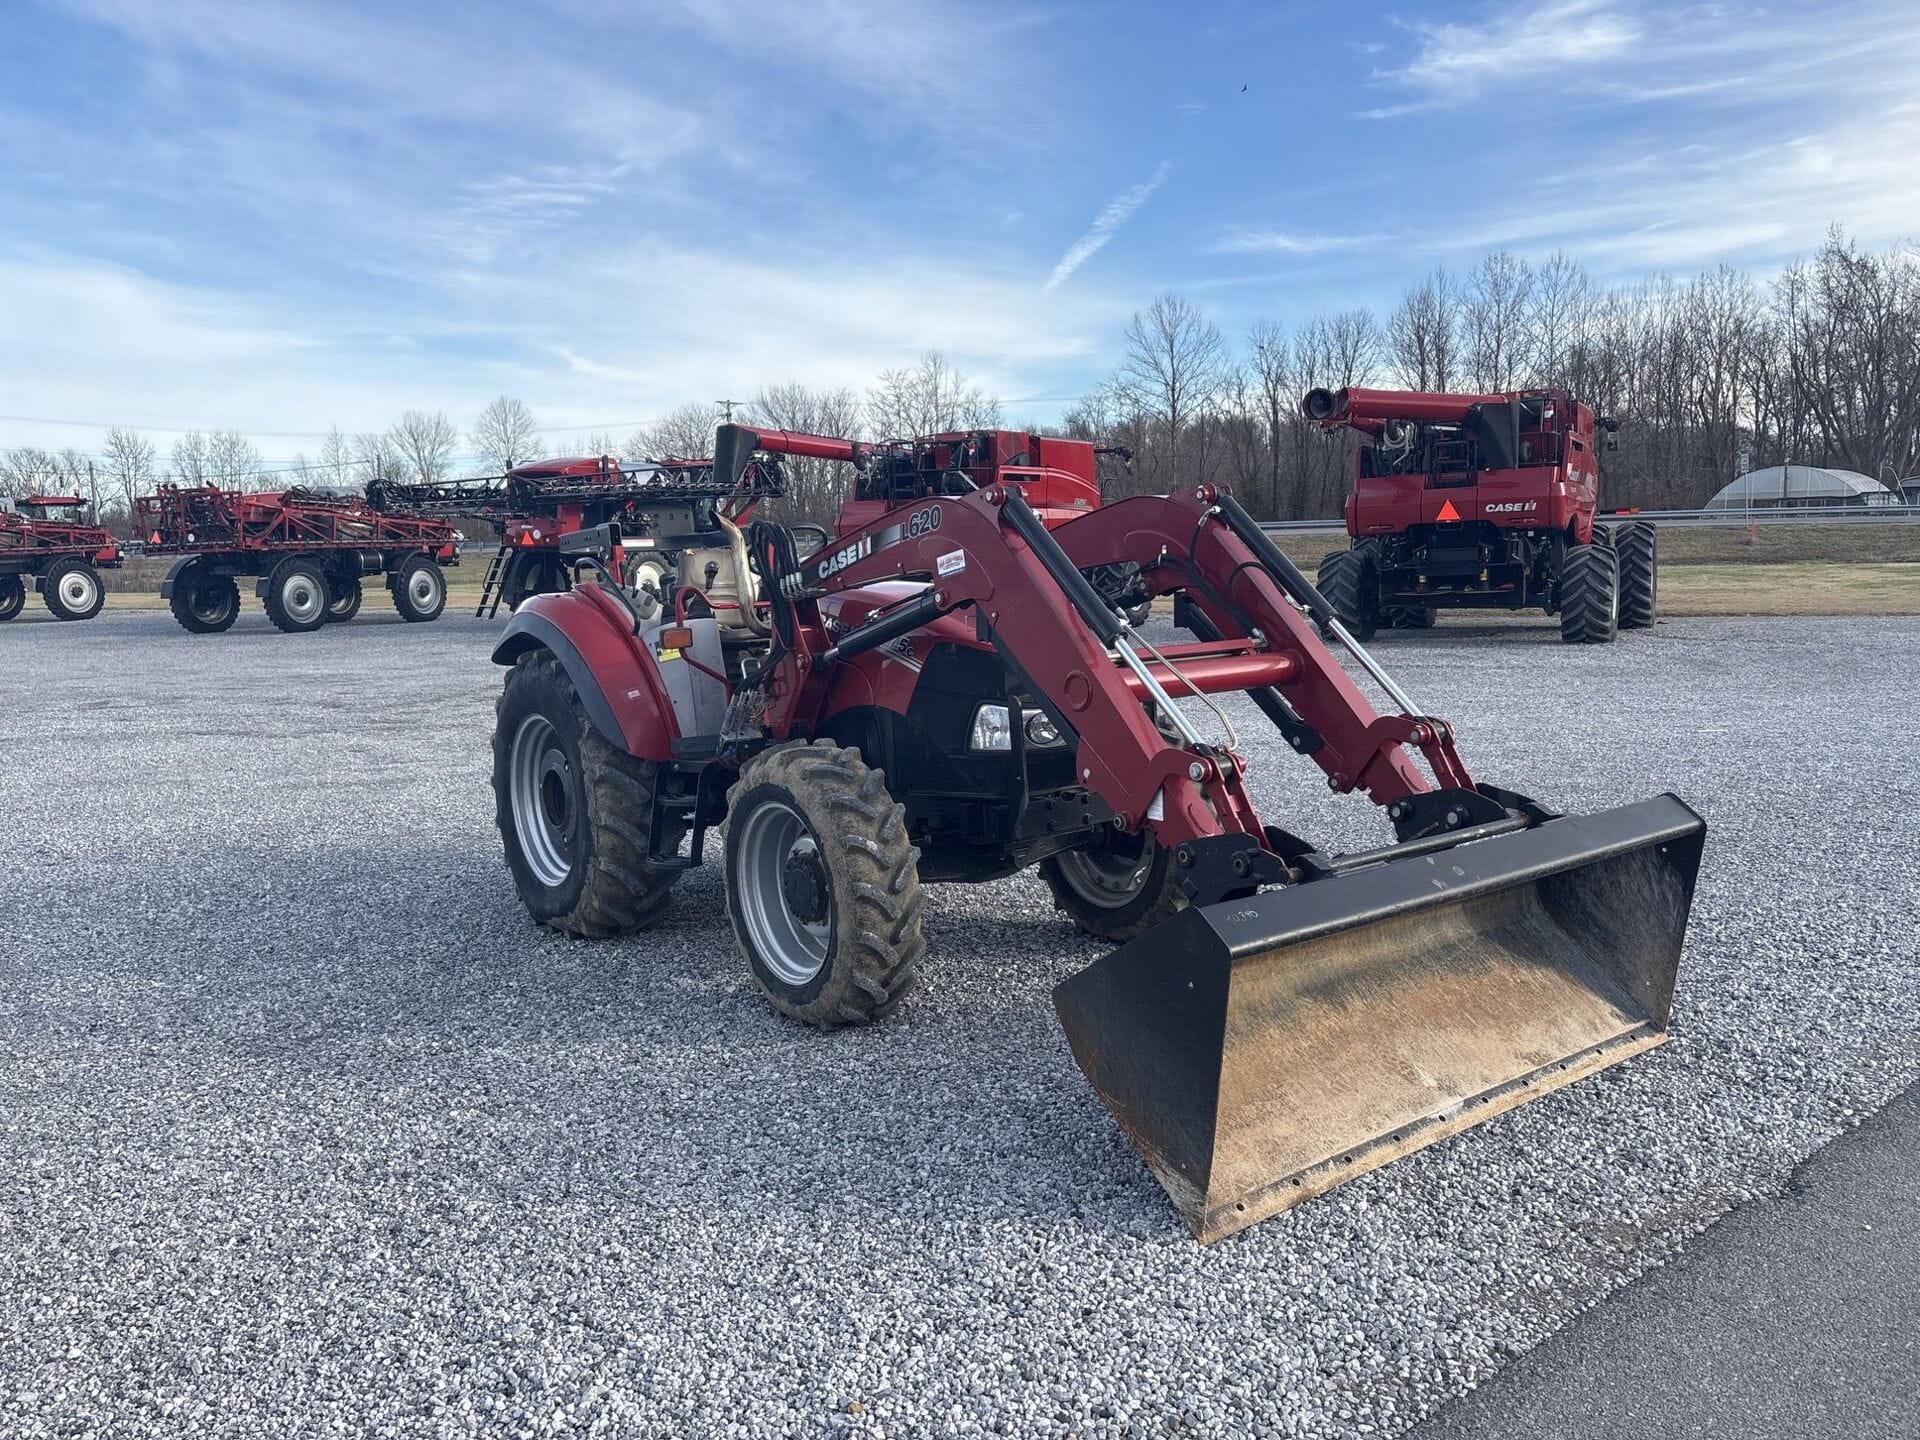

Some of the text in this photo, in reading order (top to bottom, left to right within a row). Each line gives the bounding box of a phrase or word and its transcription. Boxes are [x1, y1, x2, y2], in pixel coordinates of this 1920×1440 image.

[900, 504, 943, 542] L620
[1485, 503, 1523, 513] CASE
[818, 543, 859, 579] CASE
